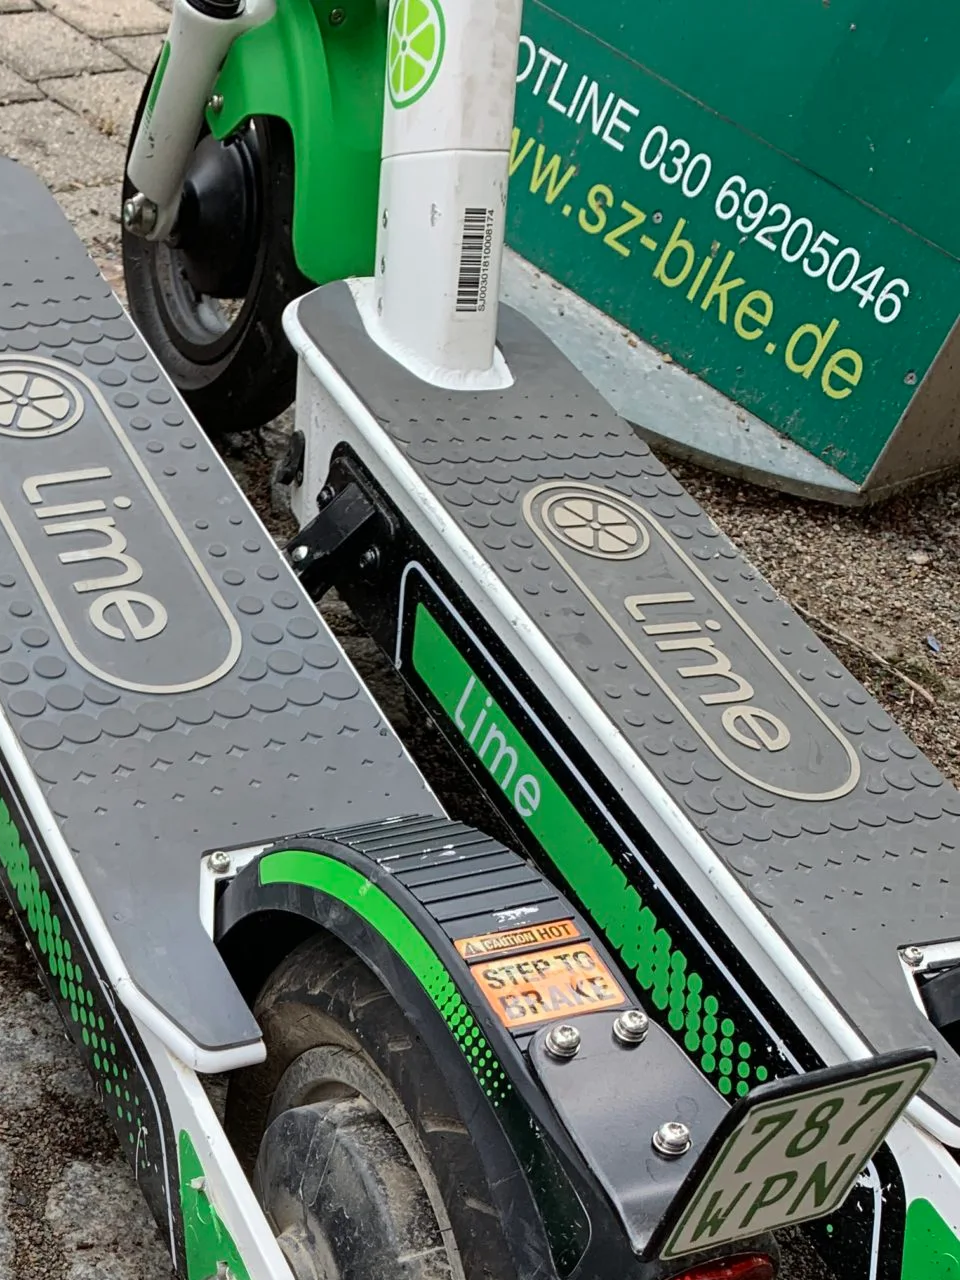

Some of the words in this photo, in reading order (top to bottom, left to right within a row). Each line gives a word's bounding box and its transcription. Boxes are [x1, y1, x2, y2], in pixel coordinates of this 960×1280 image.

[640, 125, 712, 198] 030
[715, 175, 910, 324] 69205046
[22, 467, 168, 641] Lime
[624, 592, 790, 752] Lime
[455, 675, 540, 816] Lime
[483, 959, 549, 990] STEP
[554, 951, 596, 973] TO
[484, 931, 534, 951] CAUTION
[540, 923, 572, 941] HOT
[498, 977, 616, 1020] BRAKE
[734, 1081, 904, 1173] 787
[690, 1153, 855, 1242] WPN
